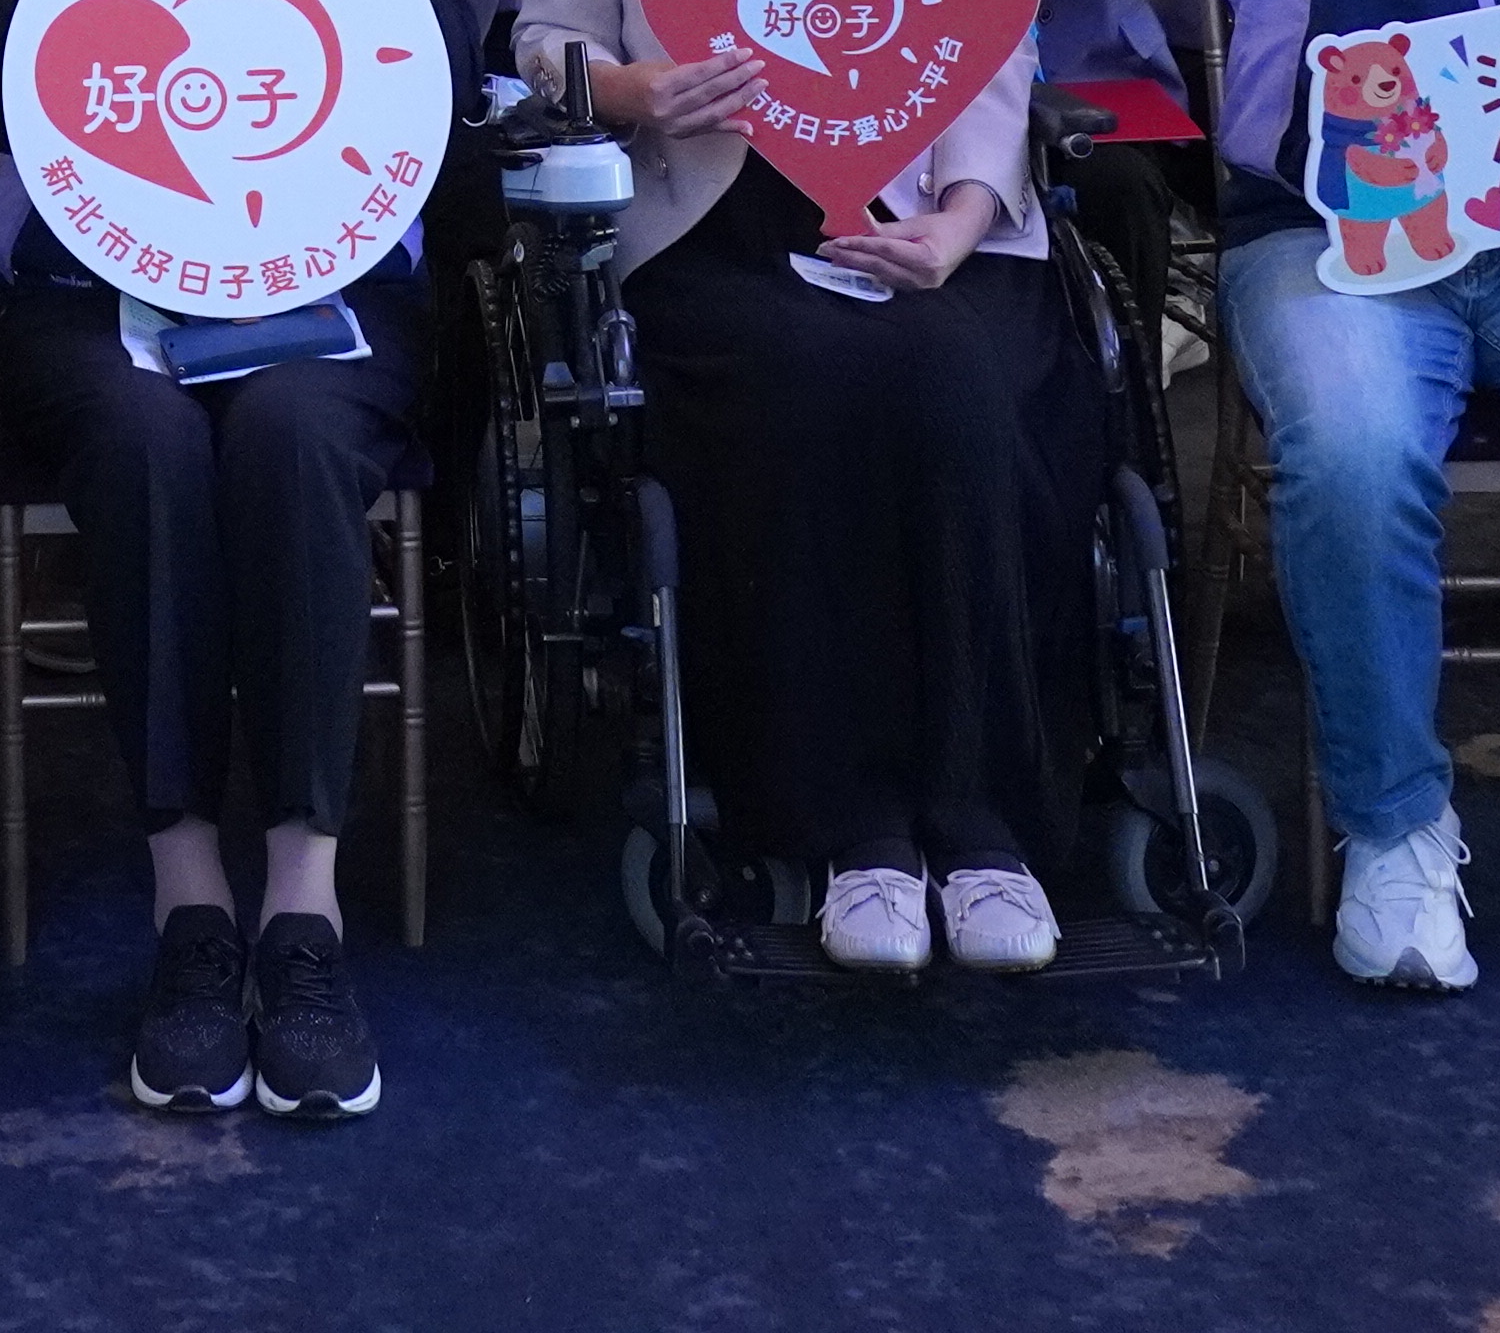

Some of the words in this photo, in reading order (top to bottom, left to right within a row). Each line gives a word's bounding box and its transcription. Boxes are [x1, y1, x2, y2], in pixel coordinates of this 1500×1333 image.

[41, 150, 424, 300] 新北市好日子愛心大平台
